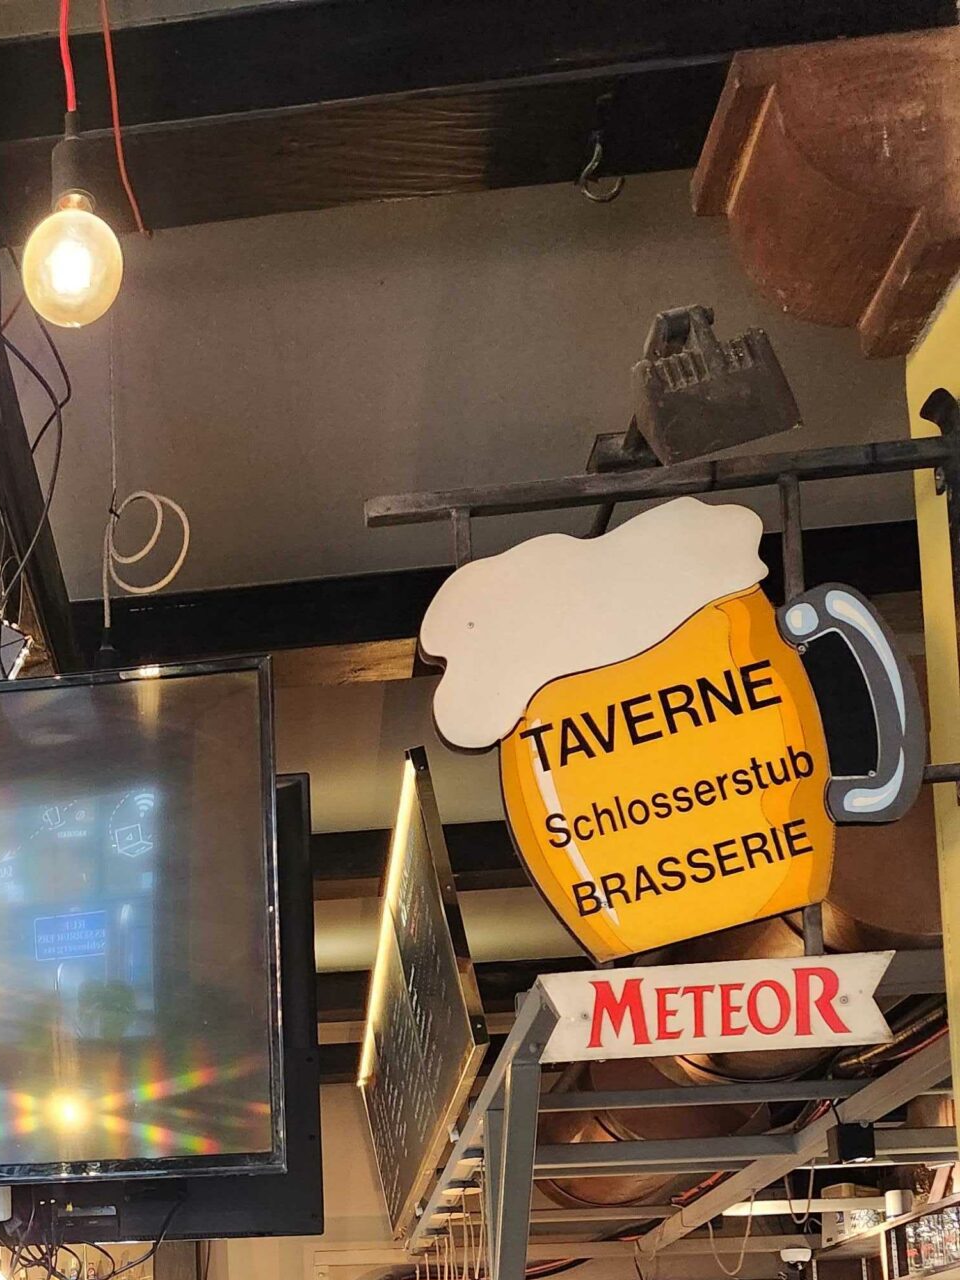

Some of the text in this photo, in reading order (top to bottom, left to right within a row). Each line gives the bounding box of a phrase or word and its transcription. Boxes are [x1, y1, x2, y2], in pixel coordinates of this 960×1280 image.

[520, 660, 782, 773] TAVERNE
[545, 746, 814, 849] Schlosserstub
[571, 819, 814, 917] BRASSERIE
[587, 967, 851, 1048] METEOR
